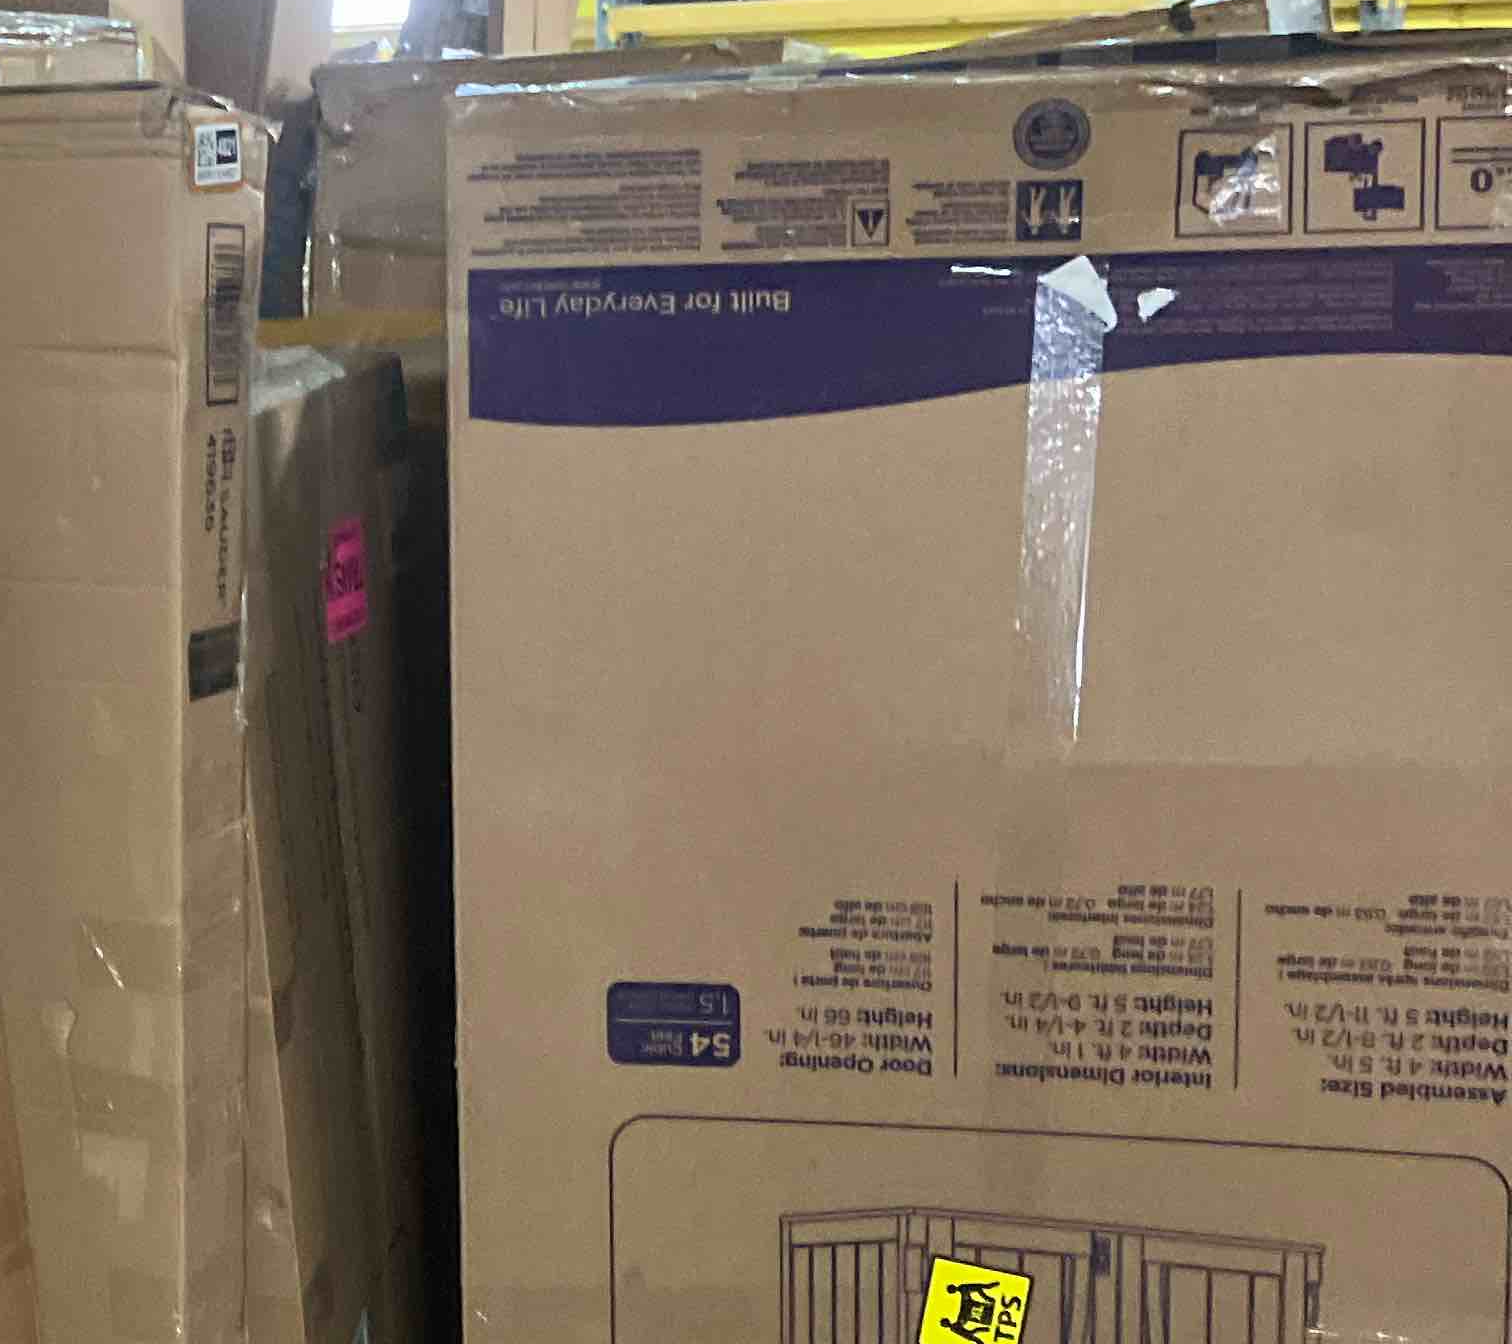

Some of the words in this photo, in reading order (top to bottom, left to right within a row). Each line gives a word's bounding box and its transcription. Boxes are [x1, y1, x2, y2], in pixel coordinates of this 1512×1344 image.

[500, 295, 547, 320] Life
[555, 290, 677, 318] Everyday
[686, 291, 721, 315] for
[730, 290, 791, 314] Built
[1114, 996, 1128, 1012] 5
[858, 1007, 933, 1029] Height:
[1406, 1008, 1418, 1025] 5
[1120, 1020, 1131, 1037] 2
[690, 1031, 732, 1058] 54
[862, 1032, 933, 1053] Width:
[1119, 1044, 1132, 1060] 4
[779, 1051, 874, 1073] Opening:
[879, 1055, 932, 1076] Door
[1138, 1045, 1211, 1065] Width:
[1360, 1056, 1373, 1074] 5
[995, 1064, 1125, 1086] Dimensions:
[1131, 1068, 1212, 1089] Interior
[1409, 1061, 1423, 1075] 4
[994, 1293, 1021, 1342] TPS
